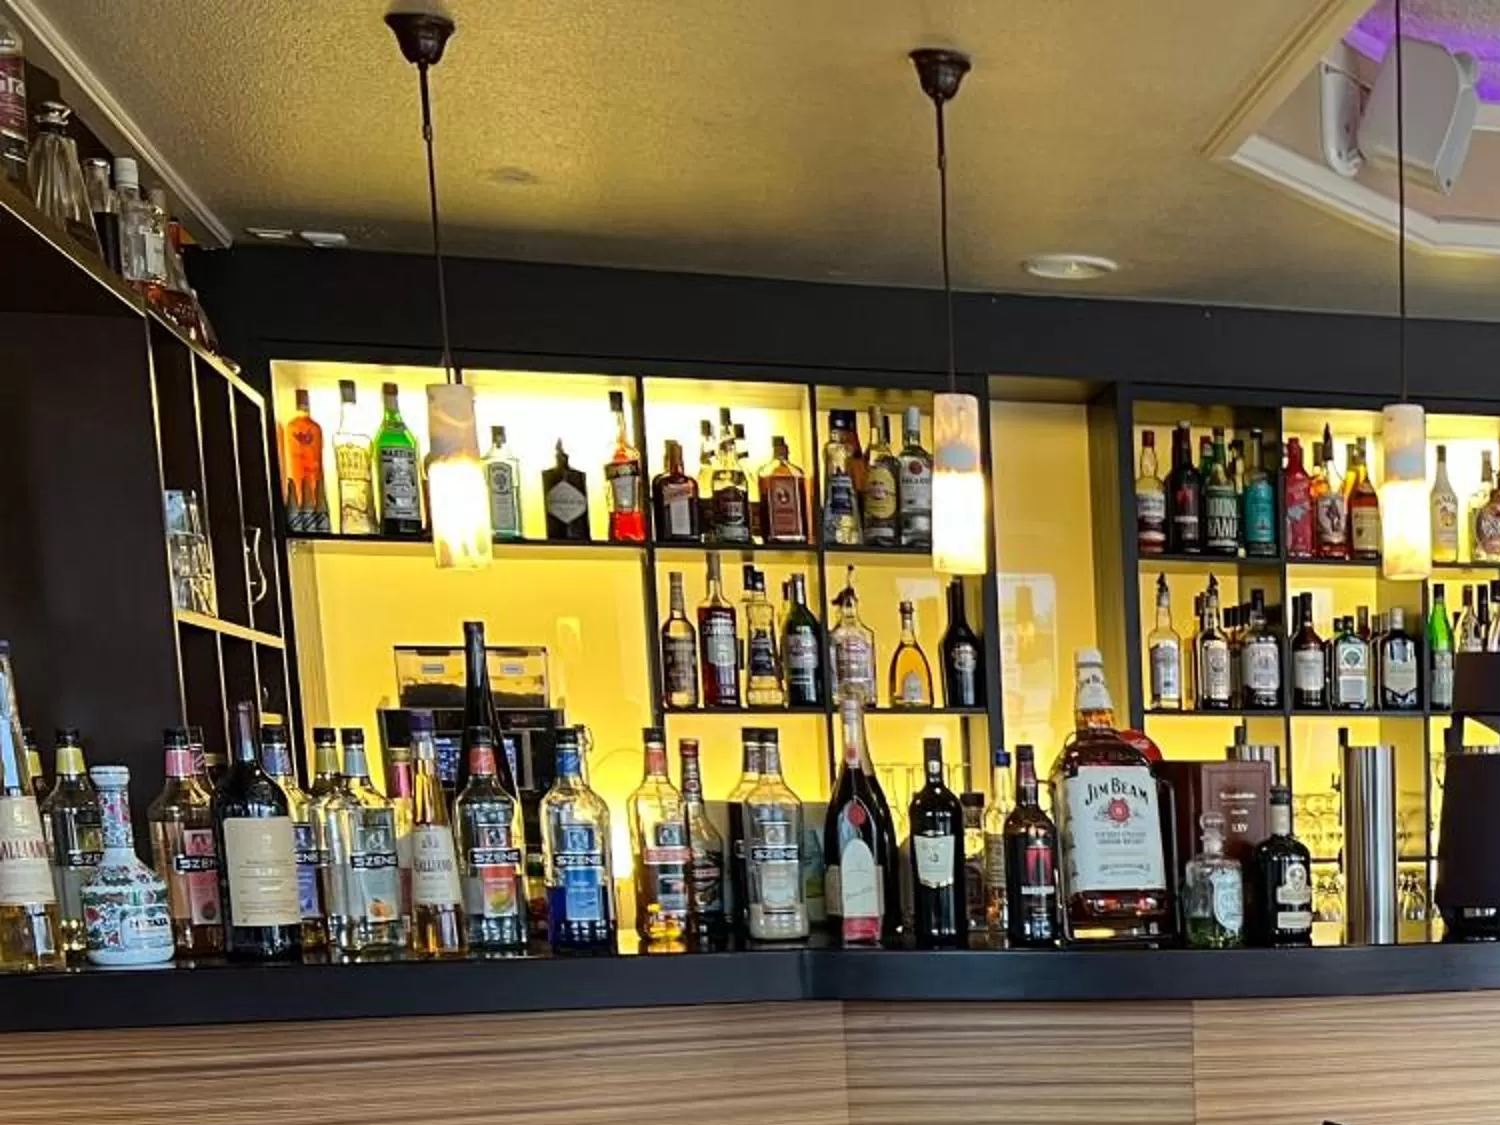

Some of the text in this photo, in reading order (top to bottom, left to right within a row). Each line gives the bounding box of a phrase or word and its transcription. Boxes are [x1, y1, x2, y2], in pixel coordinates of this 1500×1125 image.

[1085, 777, 1149, 806] JIM BEAM
[473, 851, 520, 863] SZENE
[555, 855, 602, 866] SZENE
[753, 849, 799, 860] SZENE
[353, 856, 397, 868] SZENE
